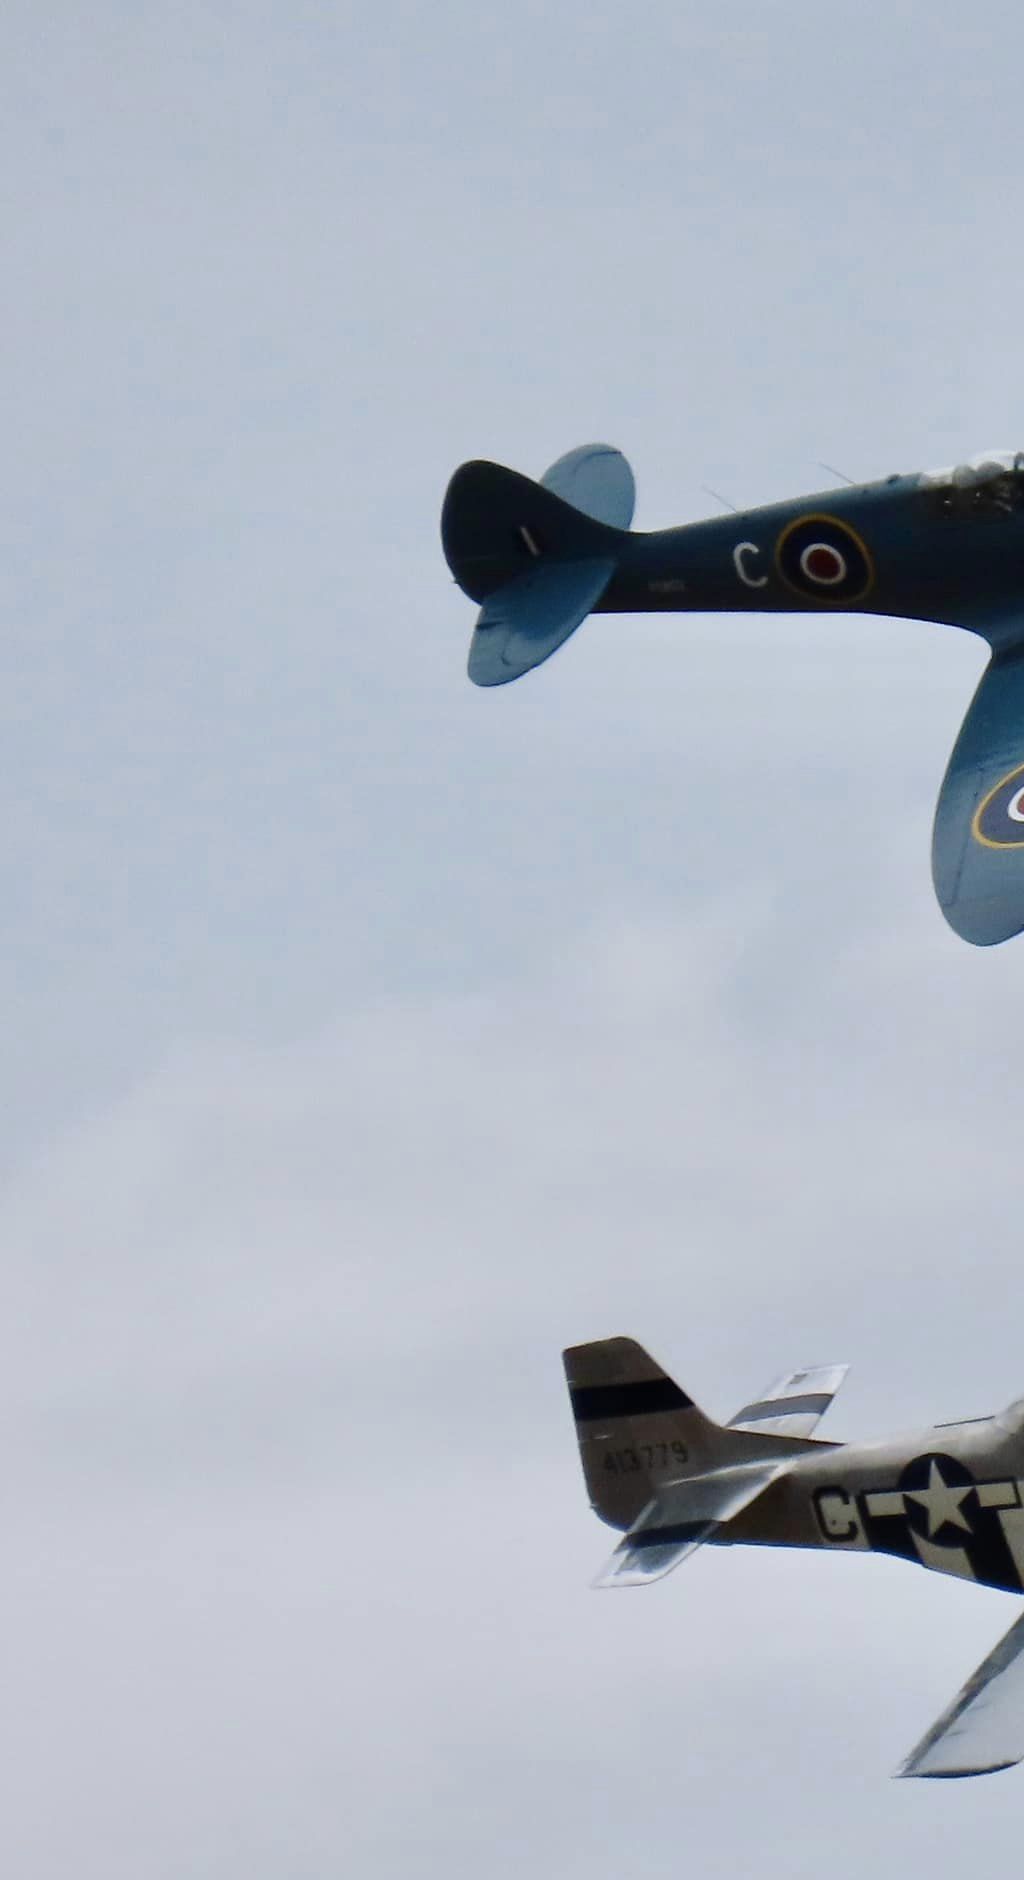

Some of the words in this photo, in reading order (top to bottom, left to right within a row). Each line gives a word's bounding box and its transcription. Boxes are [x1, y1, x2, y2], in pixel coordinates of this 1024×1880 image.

[733, 541, 769, 588] C
[604, 1440, 689, 1472] 413779
[812, 1486, 858, 1543] C
